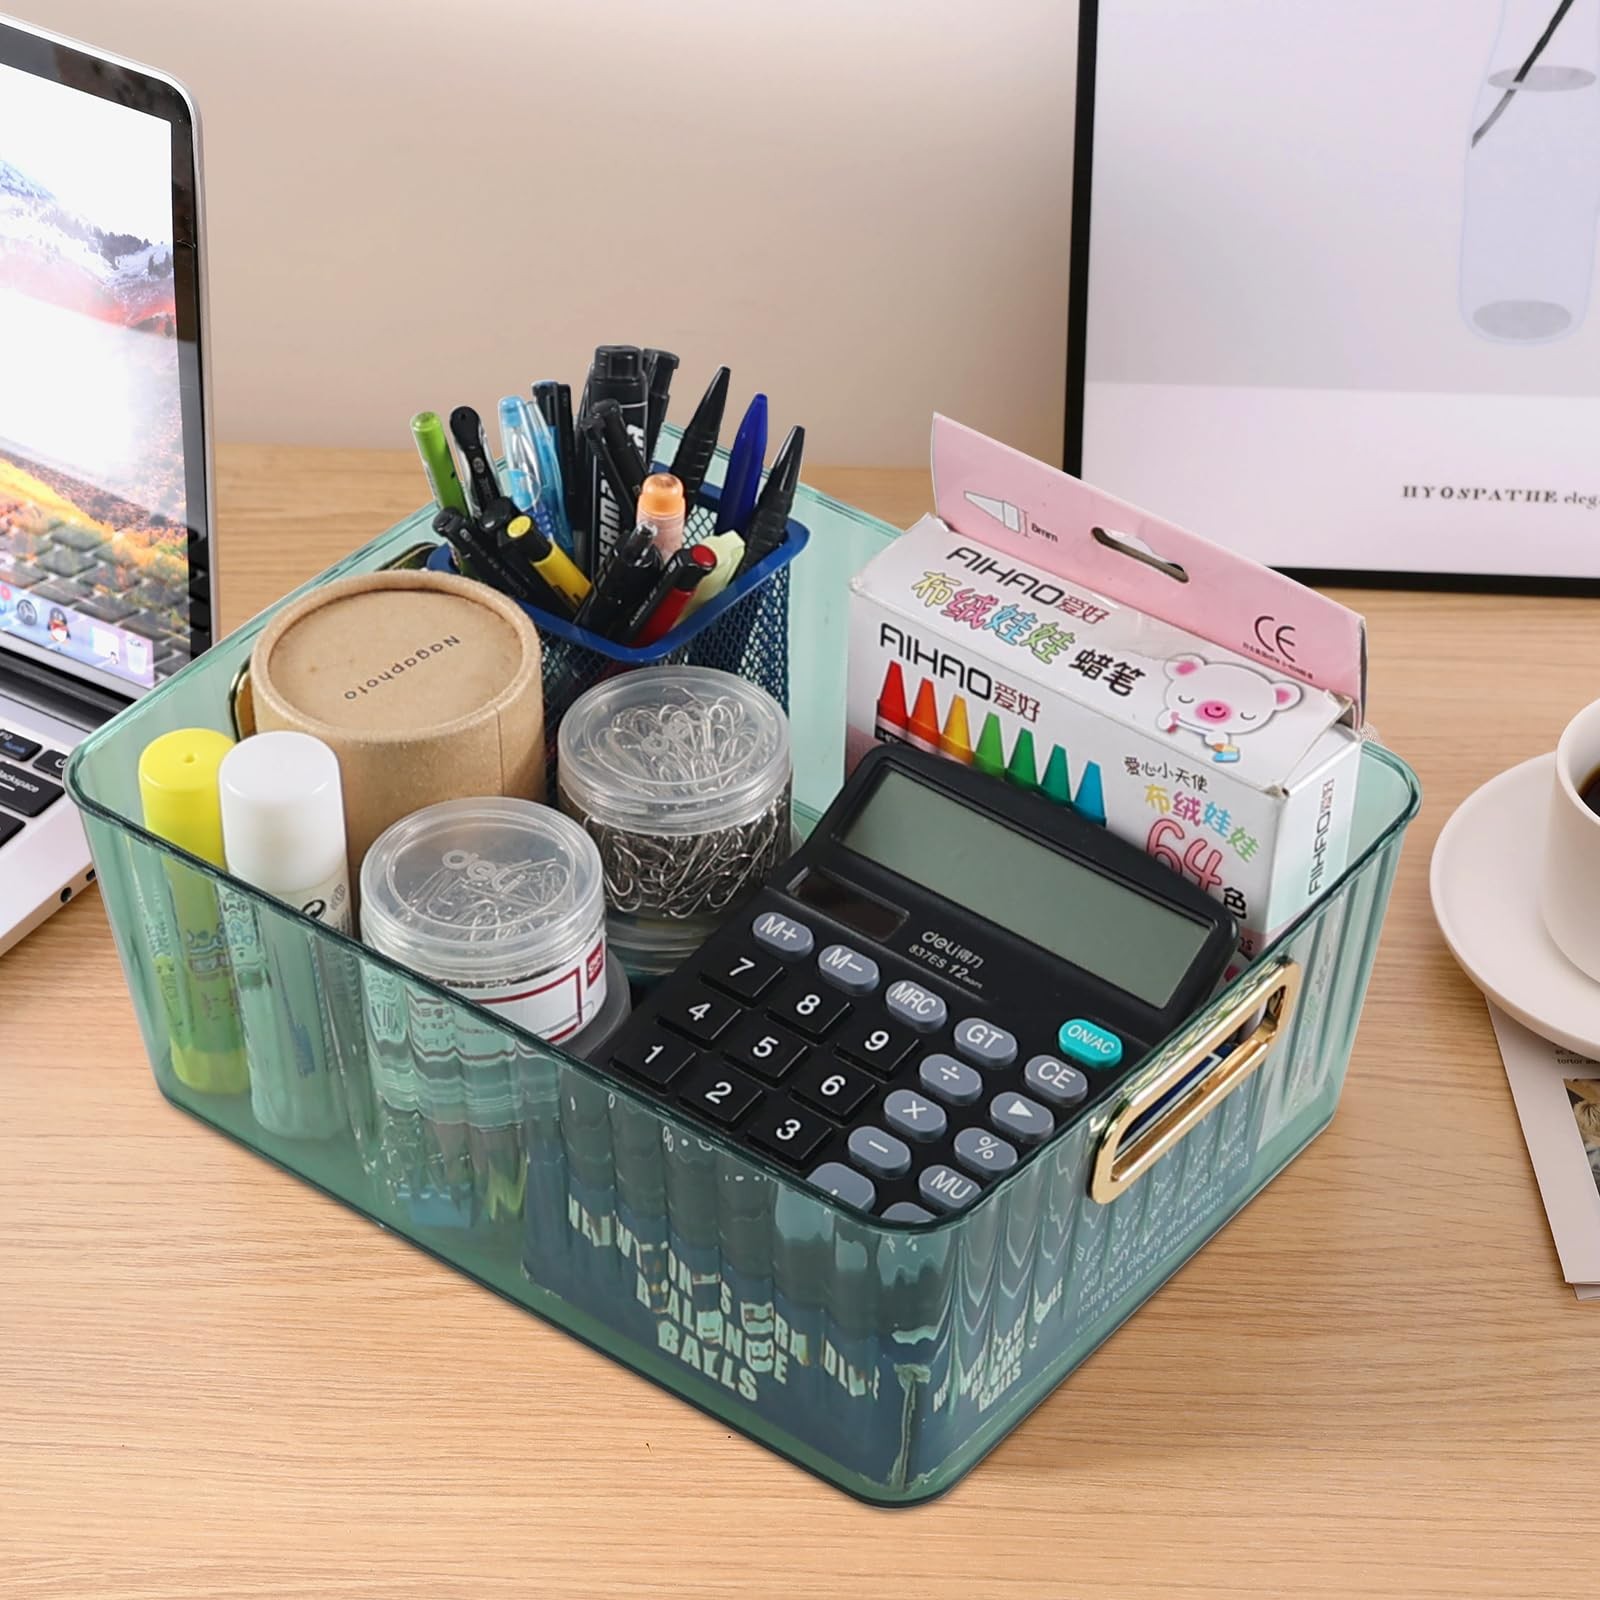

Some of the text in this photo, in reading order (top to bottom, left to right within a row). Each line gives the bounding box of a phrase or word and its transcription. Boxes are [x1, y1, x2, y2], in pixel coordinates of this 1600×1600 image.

[1402, 484, 1600, 512] HYOSPATHE eleg
[912, 571, 1147, 698] 布绒娃娃 蜡笔
[344, 635, 460, 700] Nagaphoto
[1124, 756, 1209, 794] 爱心小天使
[1144, 783, 1260, 863] 布绒娃娃
[760, 915, 798, 941] M+
[728, 957, 756, 977] 7
[688, 1002, 711, 1021] 4
[796, 994, 821, 1016] 8
[890, 982, 938, 1016] MRC
[752, 1036, 779, 1058] 5
[864, 1030, 890, 1052] 9
[966, 1024, 1005, 1049] GT
[1066, 1024, 1116, 1056] ON/AC
[644, 1044, 664, 1064] 1
[820, 1075, 846, 1096] 6
[1036, 1061, 1077, 1089] CE
[704, 1081, 733, 1104] 2
[775, 1119, 801, 1141] 3
[929, 1171, 973, 1201] MU
[656, 1320, 758, 1402] BALLS
